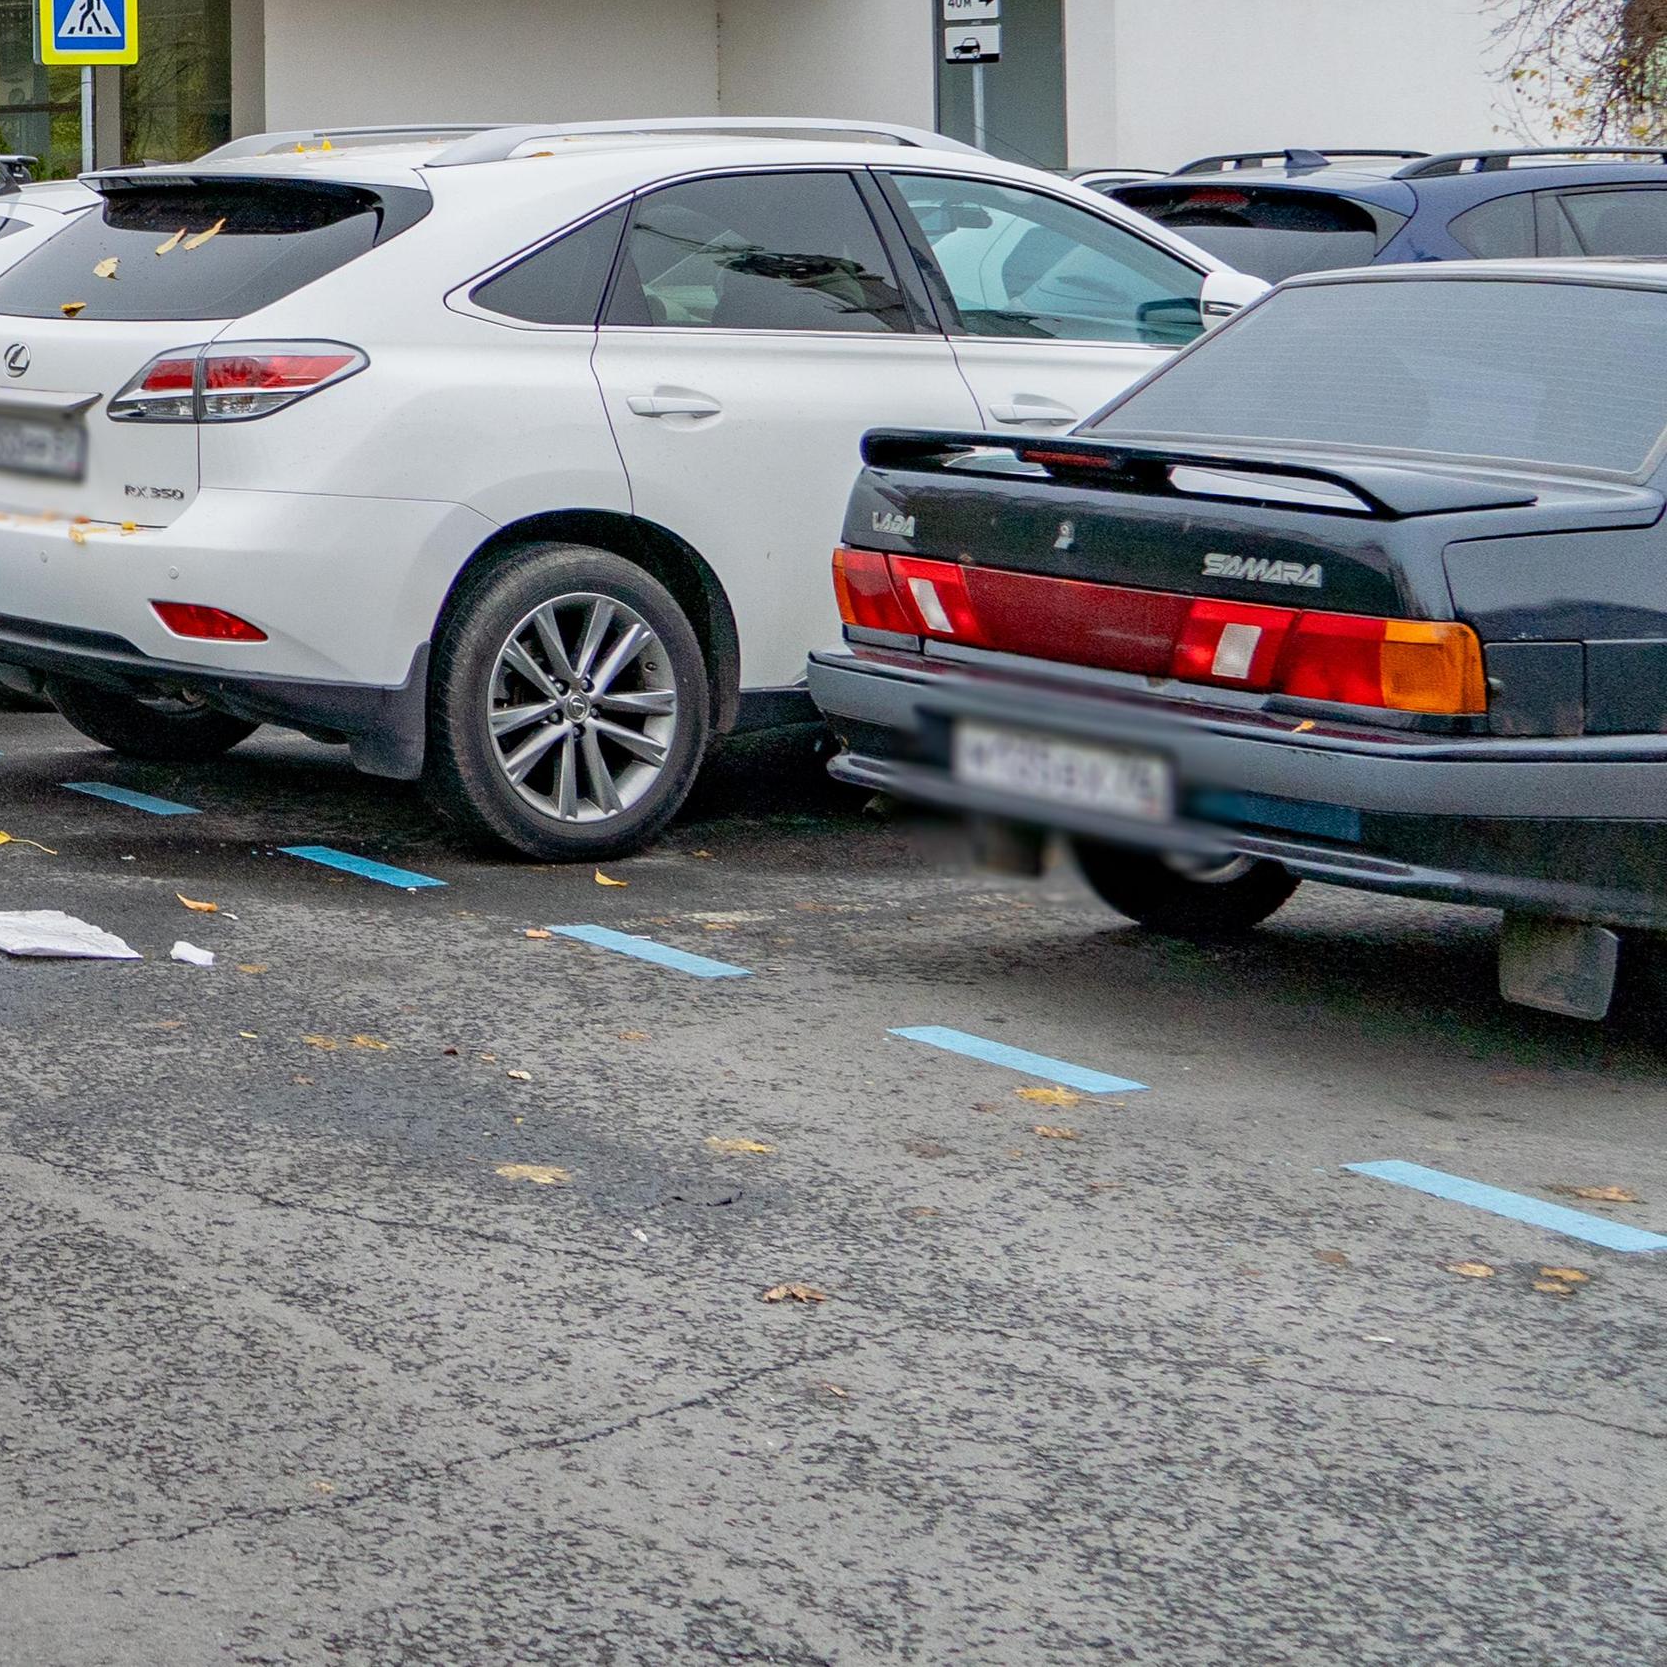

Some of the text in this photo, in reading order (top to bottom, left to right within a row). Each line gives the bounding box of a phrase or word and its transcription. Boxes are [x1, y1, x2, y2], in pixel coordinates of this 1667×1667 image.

[124, 483, 184, 500] RX 350
[871, 510, 915, 537] LADA
[1201, 552, 1322, 588] SAMARA
